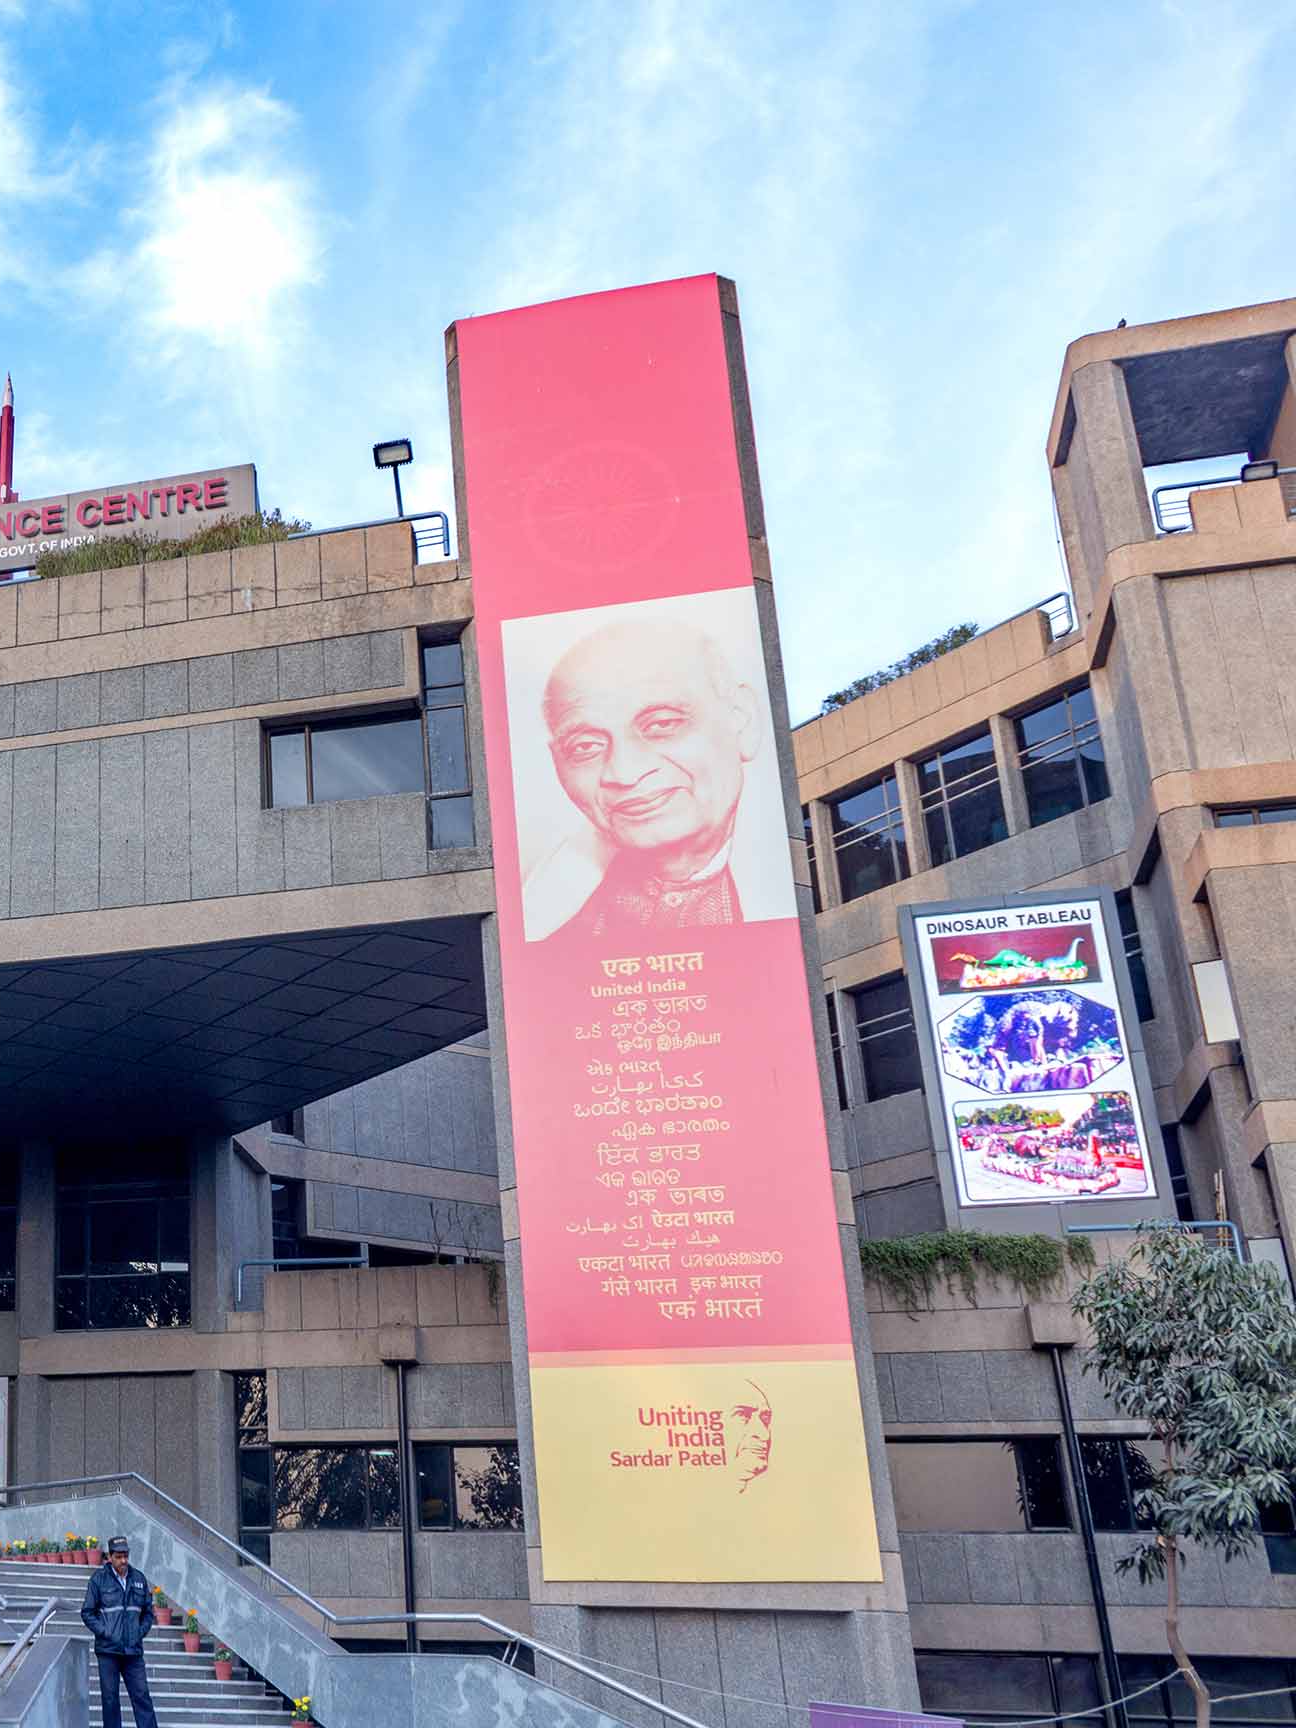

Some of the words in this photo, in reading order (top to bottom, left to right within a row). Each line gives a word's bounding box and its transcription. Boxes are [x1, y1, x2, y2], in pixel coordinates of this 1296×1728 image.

[76, 477, 229, 528] CENTRE
[926, 917, 1009, 935] DINOSAUR
[1016, 908, 1092, 927] TABLEAU
[602, 957, 640, 977] एक
[647, 952, 704, 973] भारत
[591, 982, 643, 998] United
[647, 979, 687, 995] India
[693, 1210, 734, 1226] भारत
[628, 1254, 671, 1271] भारत
[635, 1278, 677, 1295] भारत
[720, 1274, 763, 1289] भारत
[638, 1405, 724, 1432] Uniting
[668, 1426, 725, 1448] India
[610, 1449, 673, 1467] Sardar
[679, 1448, 727, 1467] Patel
